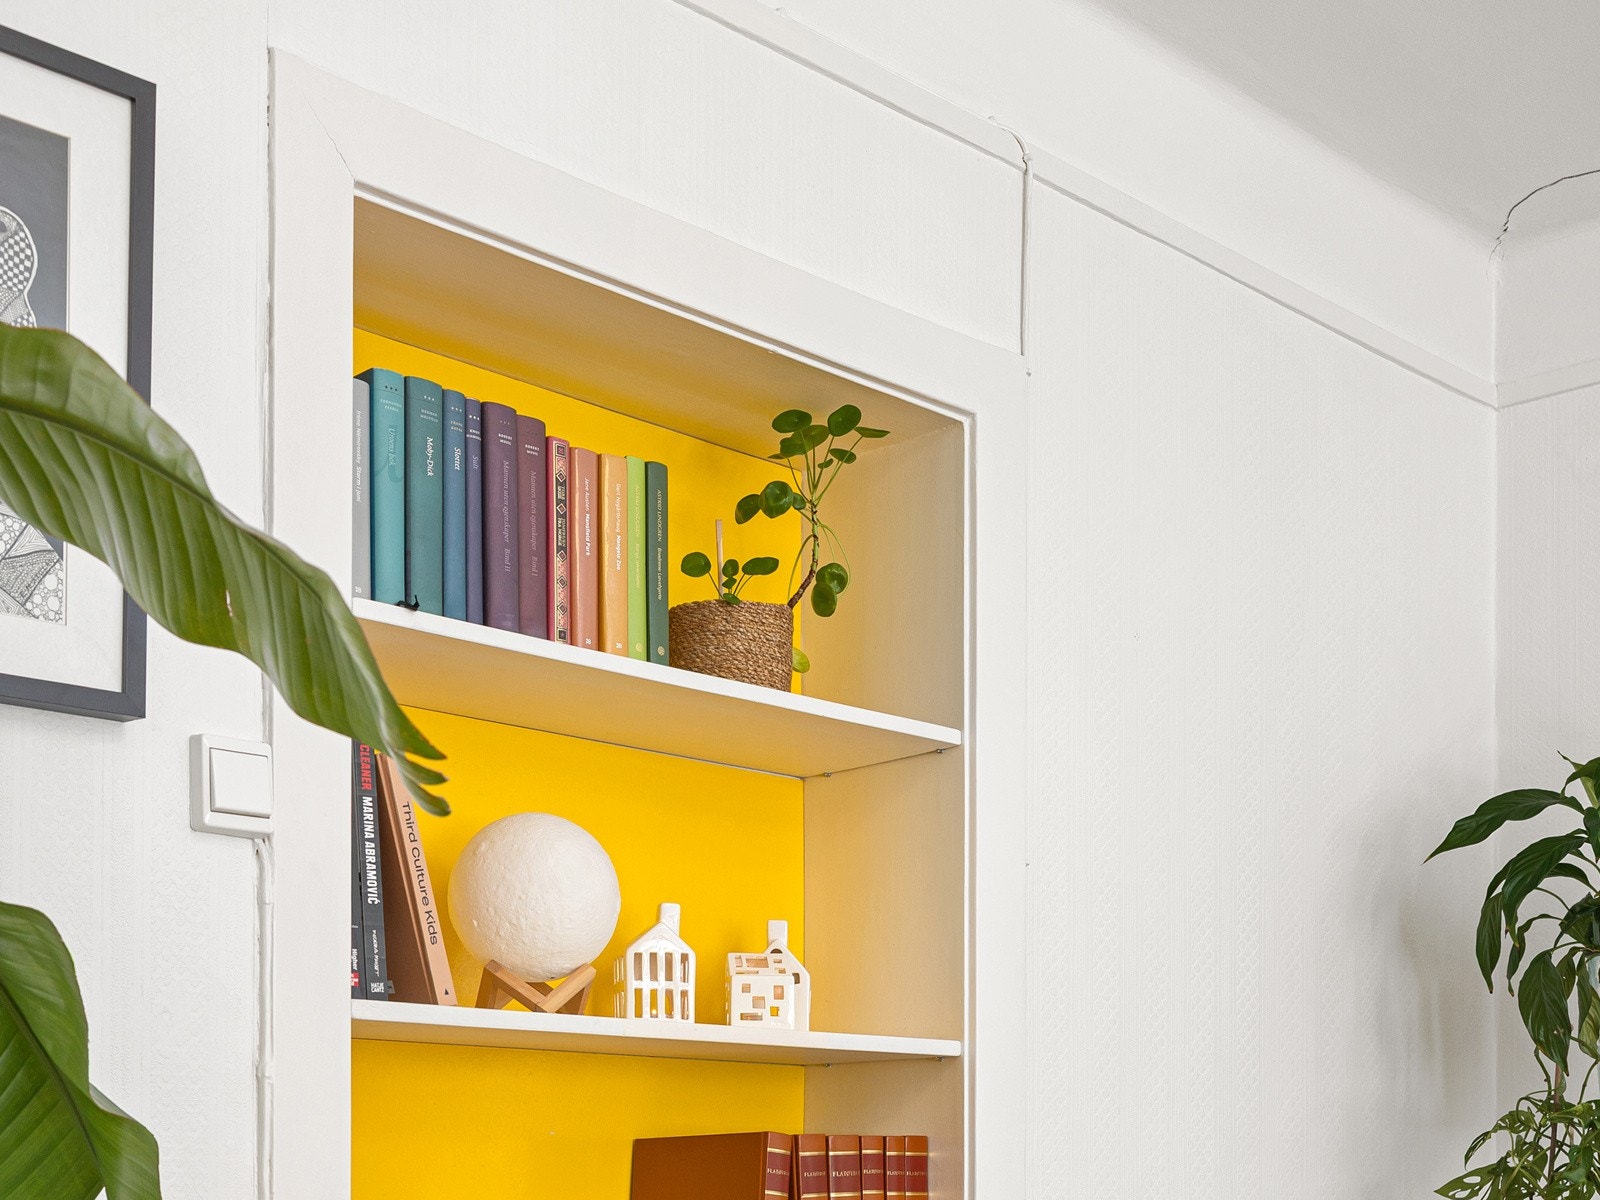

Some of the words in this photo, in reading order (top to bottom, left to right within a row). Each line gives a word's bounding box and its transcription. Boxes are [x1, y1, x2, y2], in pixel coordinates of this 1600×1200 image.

[425, 436, 434, 477] Moby-Dick
[502, 506, 510, 543] egenskaper
[529, 514, 538, 551] egenskaper
[359, 744, 373, 790] CLEANER
[362, 796, 374, 839] MARINA
[365, 840, 380, 905] ABRAMOVIĆ
[402, 801, 417, 843] Third
[411, 846, 430, 906] Culture
[424, 911, 437, 945] Kids
